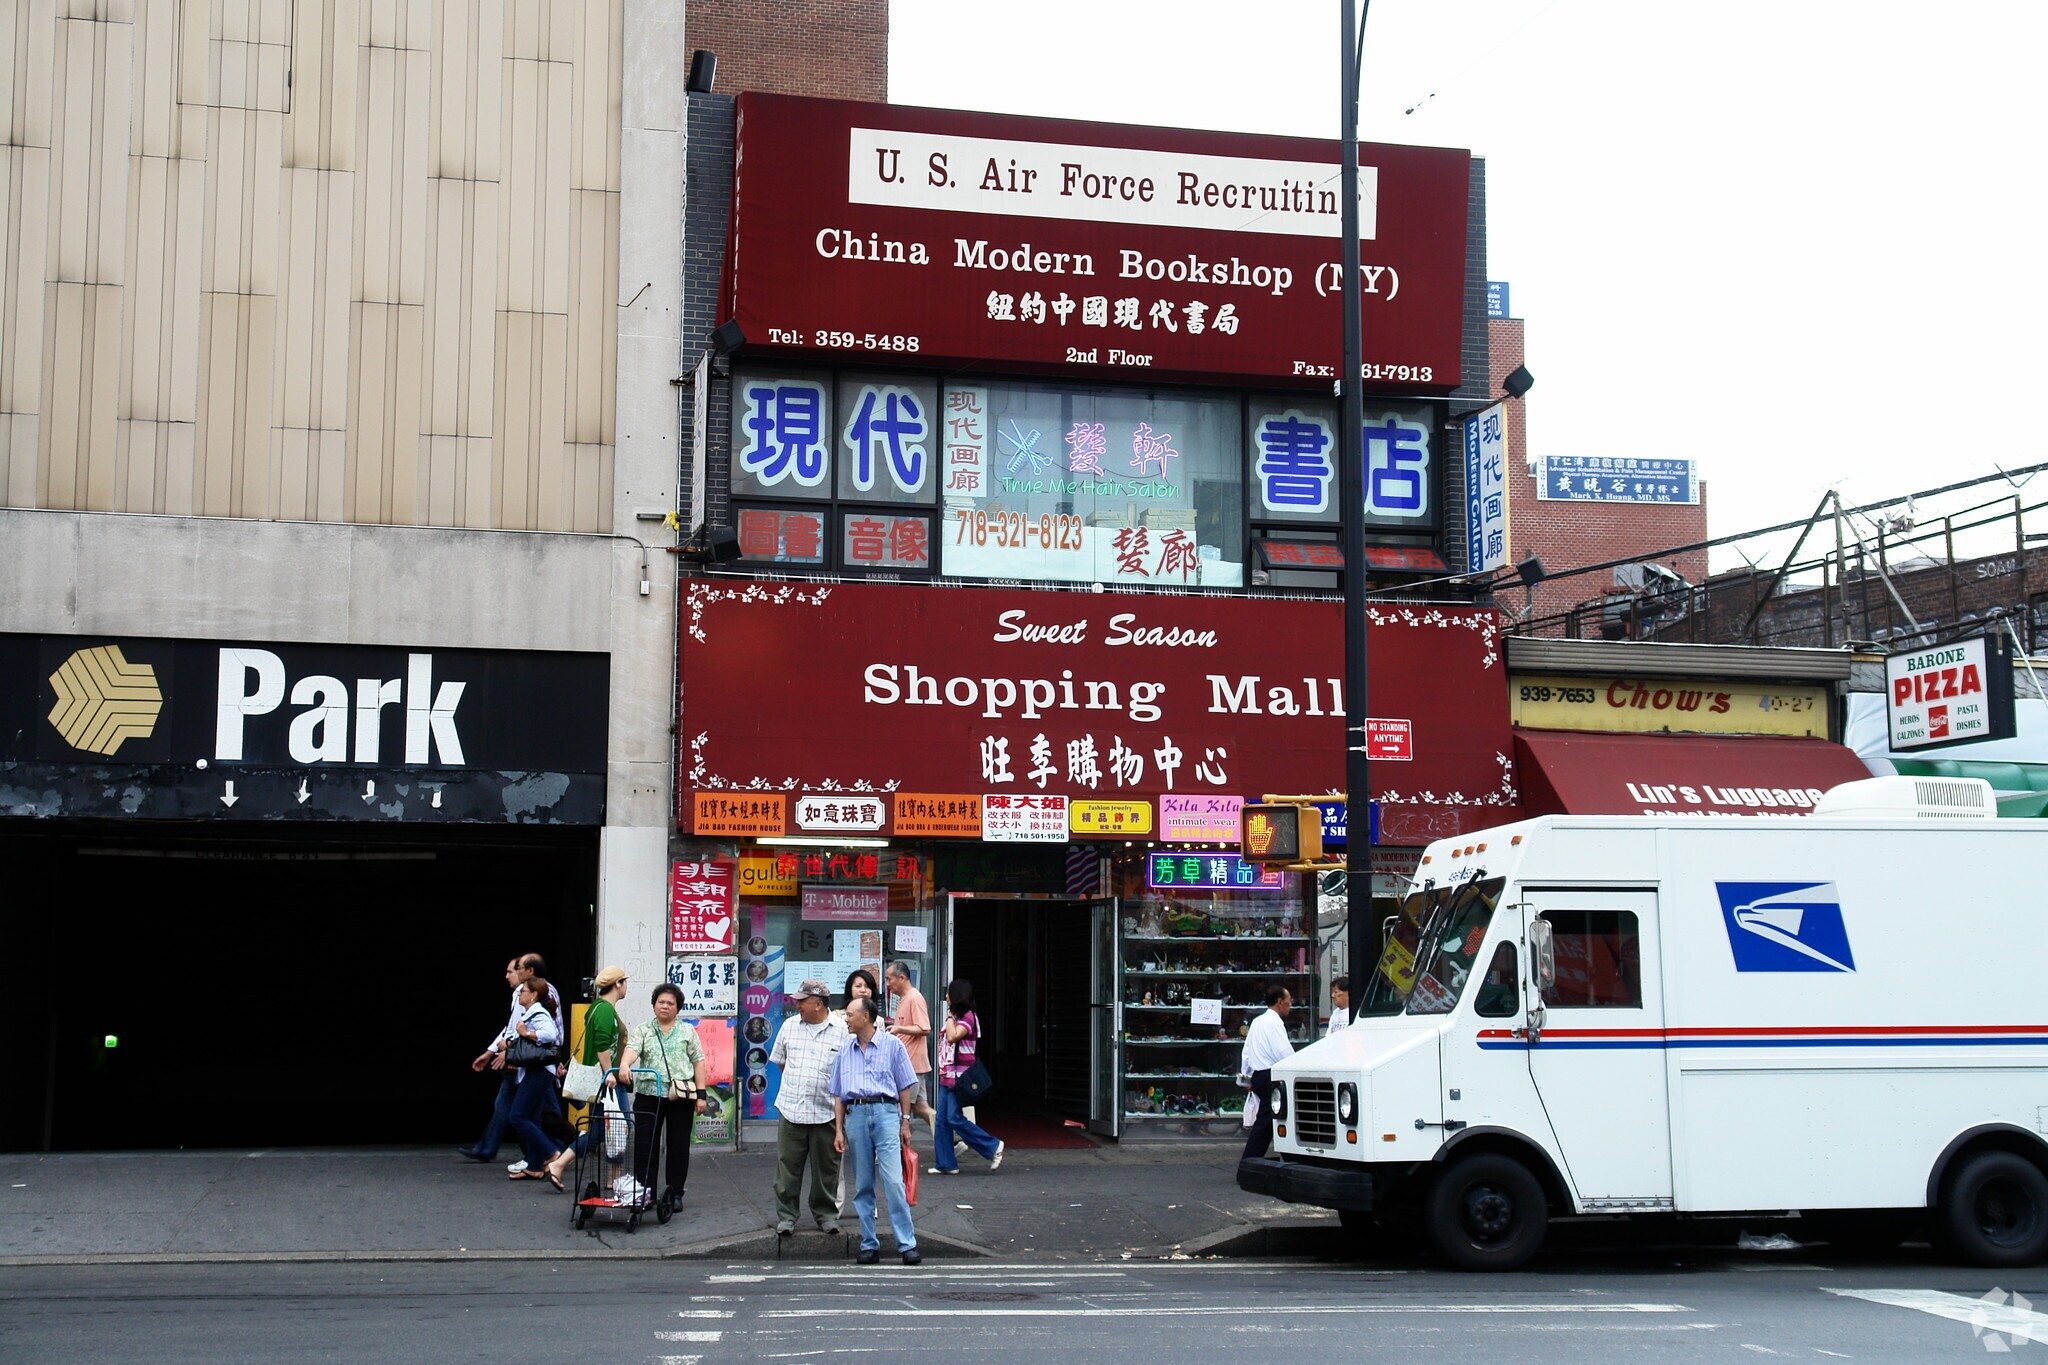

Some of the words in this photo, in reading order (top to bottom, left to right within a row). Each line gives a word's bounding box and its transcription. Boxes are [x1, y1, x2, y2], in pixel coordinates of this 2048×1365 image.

[876, 148, 905, 184] U.
[928, 152, 956, 188] S.
[979, 157, 1037, 193] Air
[1060, 163, 1154, 202] Force
[1176, 171, 1361, 222] Recruitin
[815, 228, 930, 265] China
[954, 238, 1095, 275] Modern
[1119, 249, 1293, 296] Bookshop
[986, 290, 1240, 336] 紐約中國現代書局
[768, 328, 804, 345] Tel:
[815, 330, 920, 352] 359-5488
[1066, 347, 1098, 365] 2nd
[1108, 349, 1153, 367] Floor
[1293, 361, 1335, 377] Fax:
[1361, 363, 1433, 382] 61-7913
[742, 382, 927, 490] 現代
[946, 390, 983, 492] 现代画廊
[1001, 476, 1043, 493] True
[1049, 478, 1076, 494] Me
[1083, 479, 1123, 496] Hair
[1127, 480, 1179, 498] Salon
[1482, 413, 1503, 560] 现代画廊
[848, 517, 927, 562] 音像
[955, 510, 1083, 550] 718-321-8123
[993, 610, 1088, 644] Sweet
[1104, 614, 1217, 648] Season
[1907, 647, 1965, 672] BARONE
[864, 663, 1166, 723] Shopping
[1206, 674, 1346, 717] Mall
[1893, 663, 1982, 707] PIZZA
[215, 647, 467, 765] Park
[1520, 686, 1595, 704] 939-7653
[1606, 679, 1731, 714] Chow's
[1899, 714, 1920, 725] HEROS
[1957, 704, 1979, 715] PASTA
[1369, 722, 1377, 731] NO
[1380, 723, 1408, 732] STANDING
[1896, 728, 1925, 741] CALZONES
[1956, 719, 1982, 731] DISHES
[1374, 734, 1404, 743] ANYTIME
[980, 733, 1228, 790] 旺季購物中心
[986, 795, 1066, 810] 陳大姐
[1164, 799, 1198, 813] Kila
[1206, 799, 1240, 813] Kila
[1626, 782, 1702, 804] Lin's
[1702, 784, 1825, 808] Luggage
[805, 803, 877, 824] 如意珠寶
[1168, 816, 1208, 826] intimate
[760, 824, 781, 832] HOUSE
[961, 824, 980, 832] FASHION
[1330, 826, 1347, 837] SH
[1380, 852, 1410, 862] MODERN
[738, 863, 797, 885] gular
[682, 1003, 705, 1011] RMA
[746, 993, 770, 1008] my
